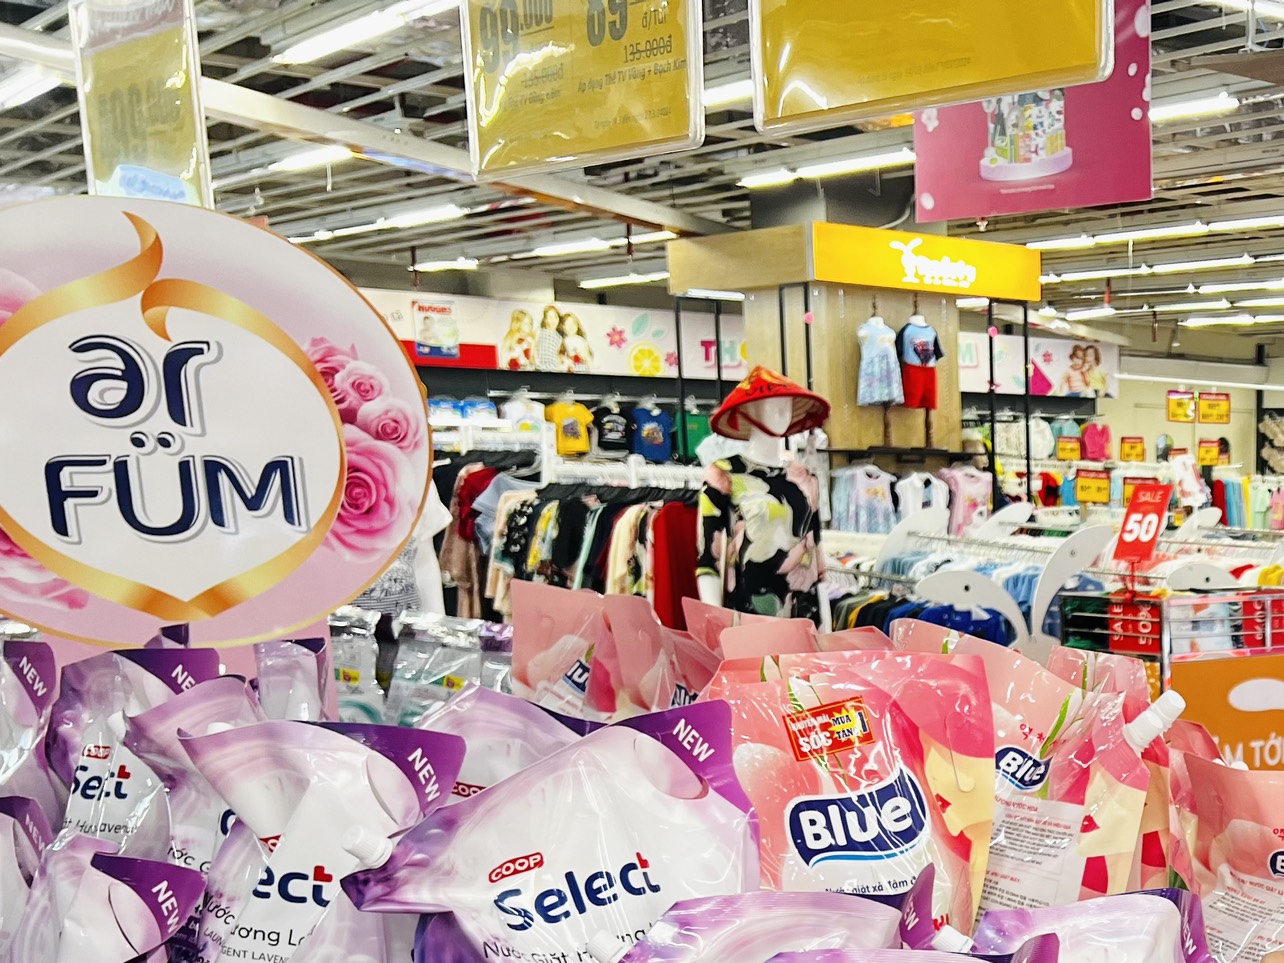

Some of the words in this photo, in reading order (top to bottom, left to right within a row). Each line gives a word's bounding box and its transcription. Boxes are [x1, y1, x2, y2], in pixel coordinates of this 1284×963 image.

[1138, 490, 1163, 504] SALE
[1121, 513, 1160, 543] 50
[18, 655, 48, 698] NEW
[671, 718, 715, 763] NEW
[831, 714, 852, 727] MUA
[407, 747, 441, 802] NEW
[998, 750, 1046, 782] Blue
[798, 794, 914, 852] Blue
[490, 854, 542, 883] COOP
[151, 880, 180, 935] NEW
[493, 852, 661, 932] Select
